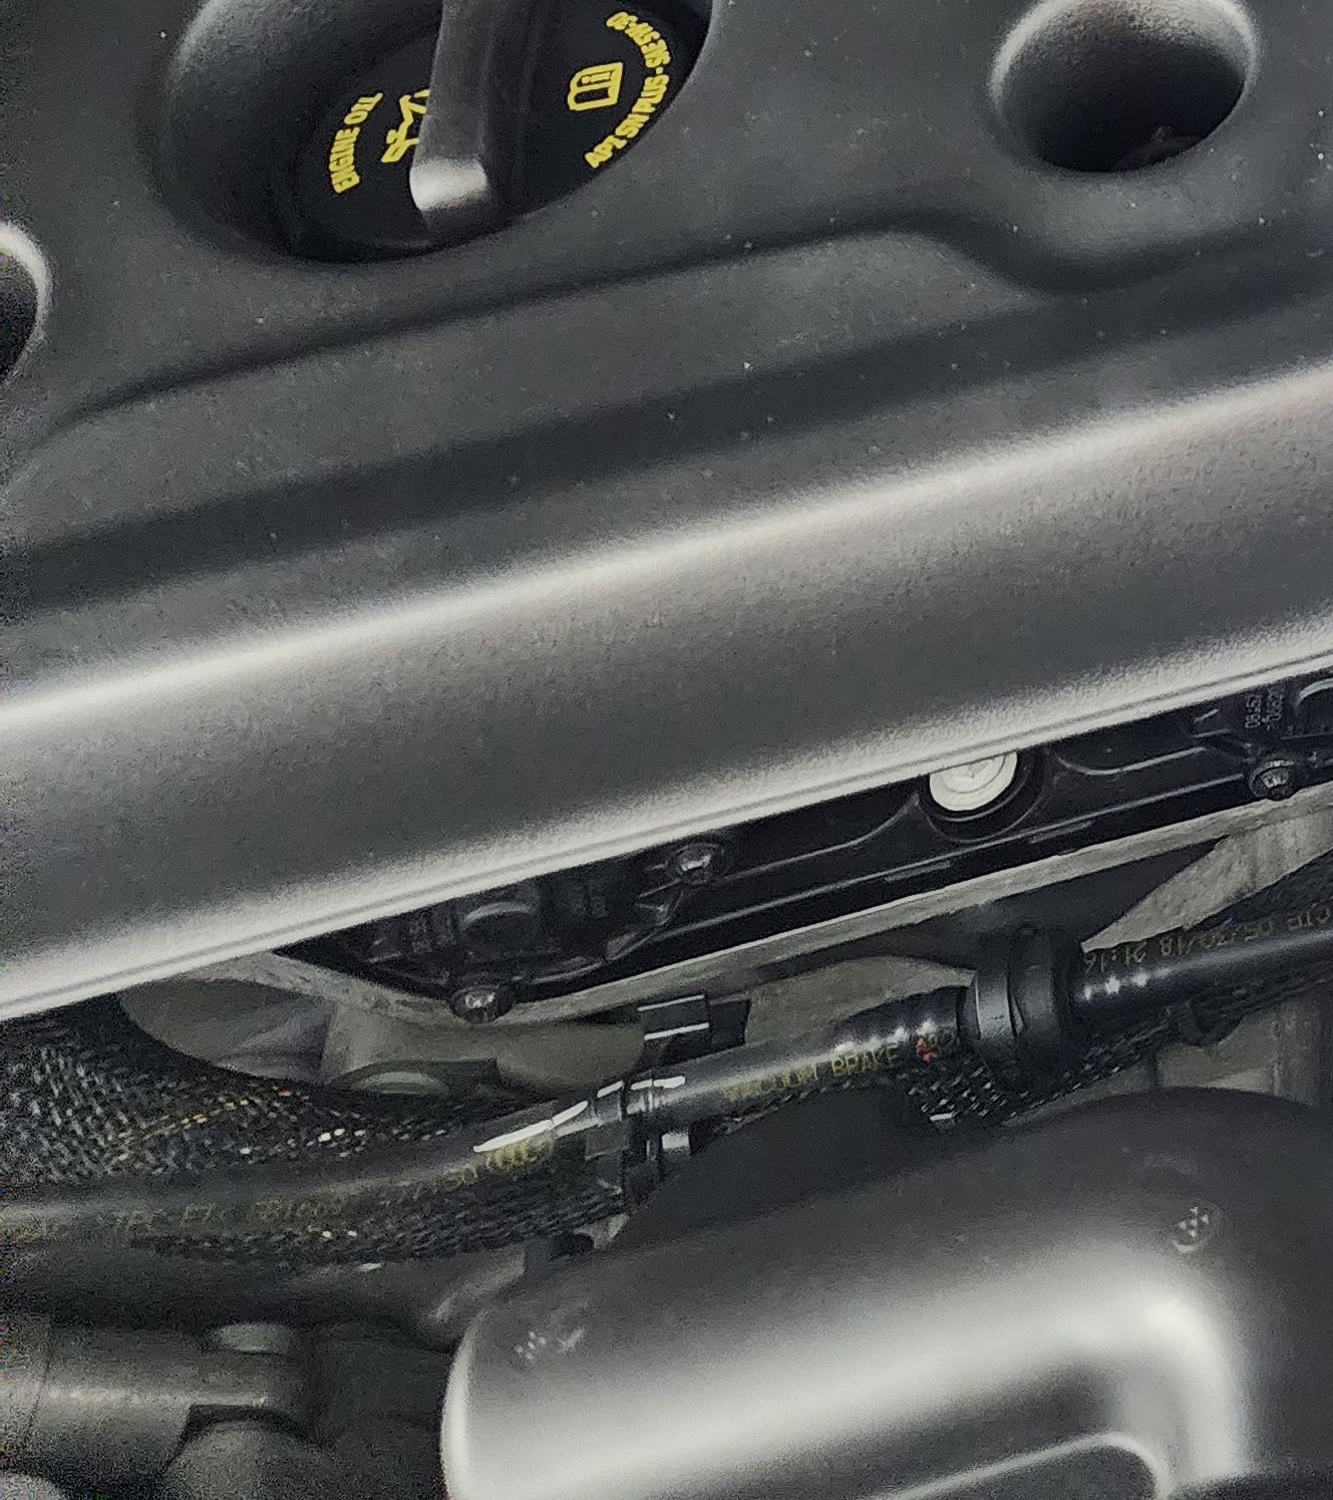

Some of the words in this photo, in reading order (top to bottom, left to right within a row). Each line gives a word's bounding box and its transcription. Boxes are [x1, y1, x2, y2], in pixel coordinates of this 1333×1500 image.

[641, 38, 671, 68] SAE
[344, 91, 384, 127] OIL
[632, 74, 670, 114] PLUS
[329, 124, 361, 194] ENGINE
